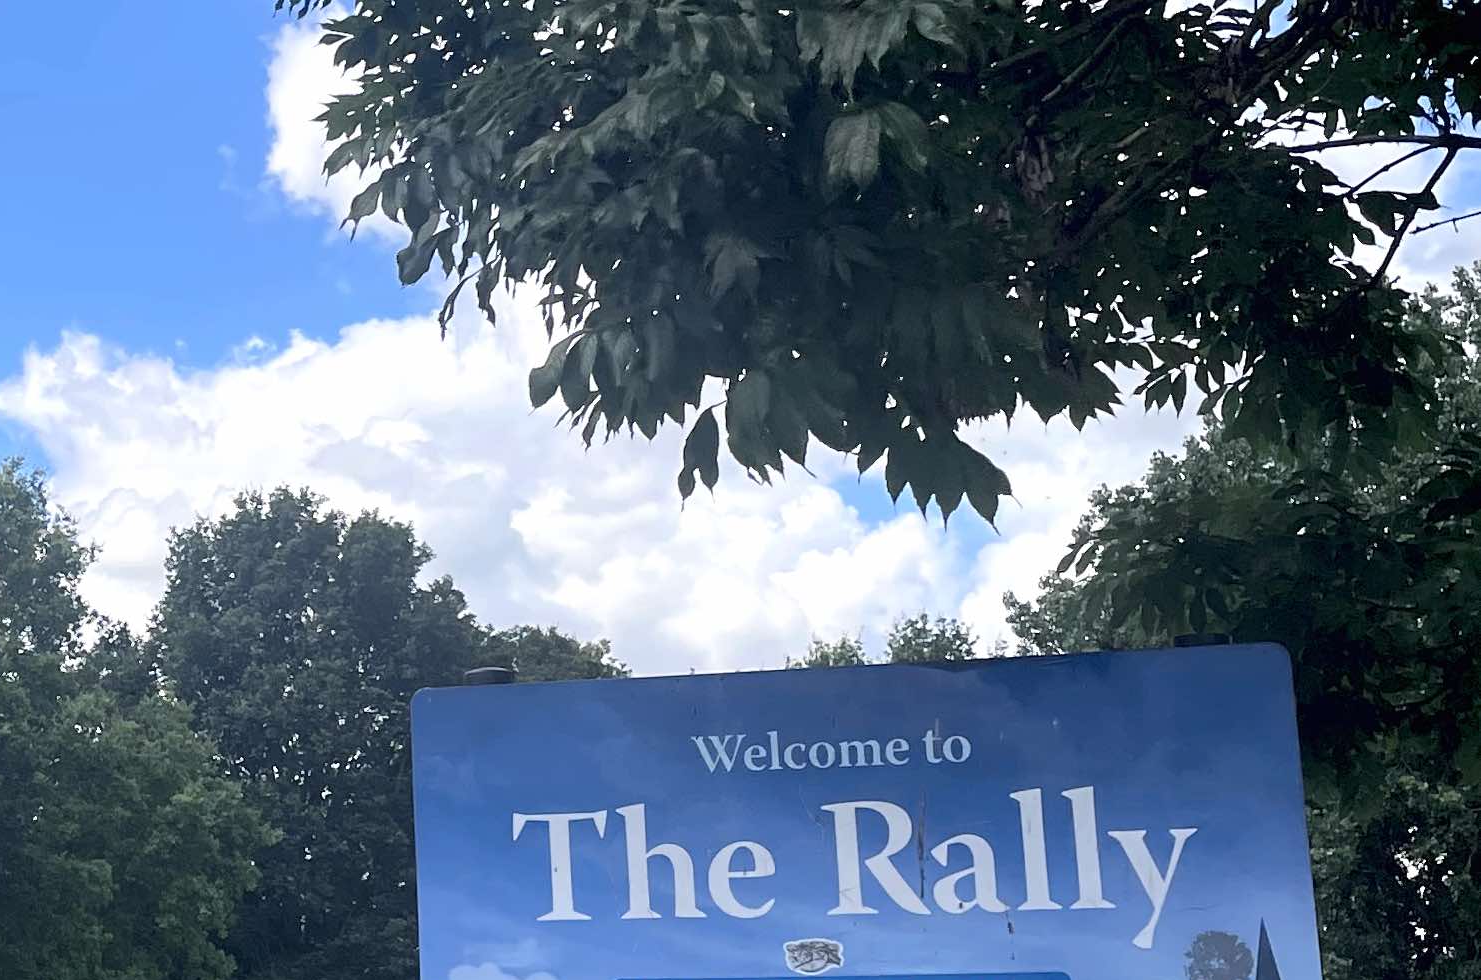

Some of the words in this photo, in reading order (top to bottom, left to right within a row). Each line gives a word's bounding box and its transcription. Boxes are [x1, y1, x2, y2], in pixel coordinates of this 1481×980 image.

[691, 731, 910, 774] Welcome
[921, 733, 972, 764] to
[512, 803, 776, 921] The
[821, 786, 1198, 949] Rally
